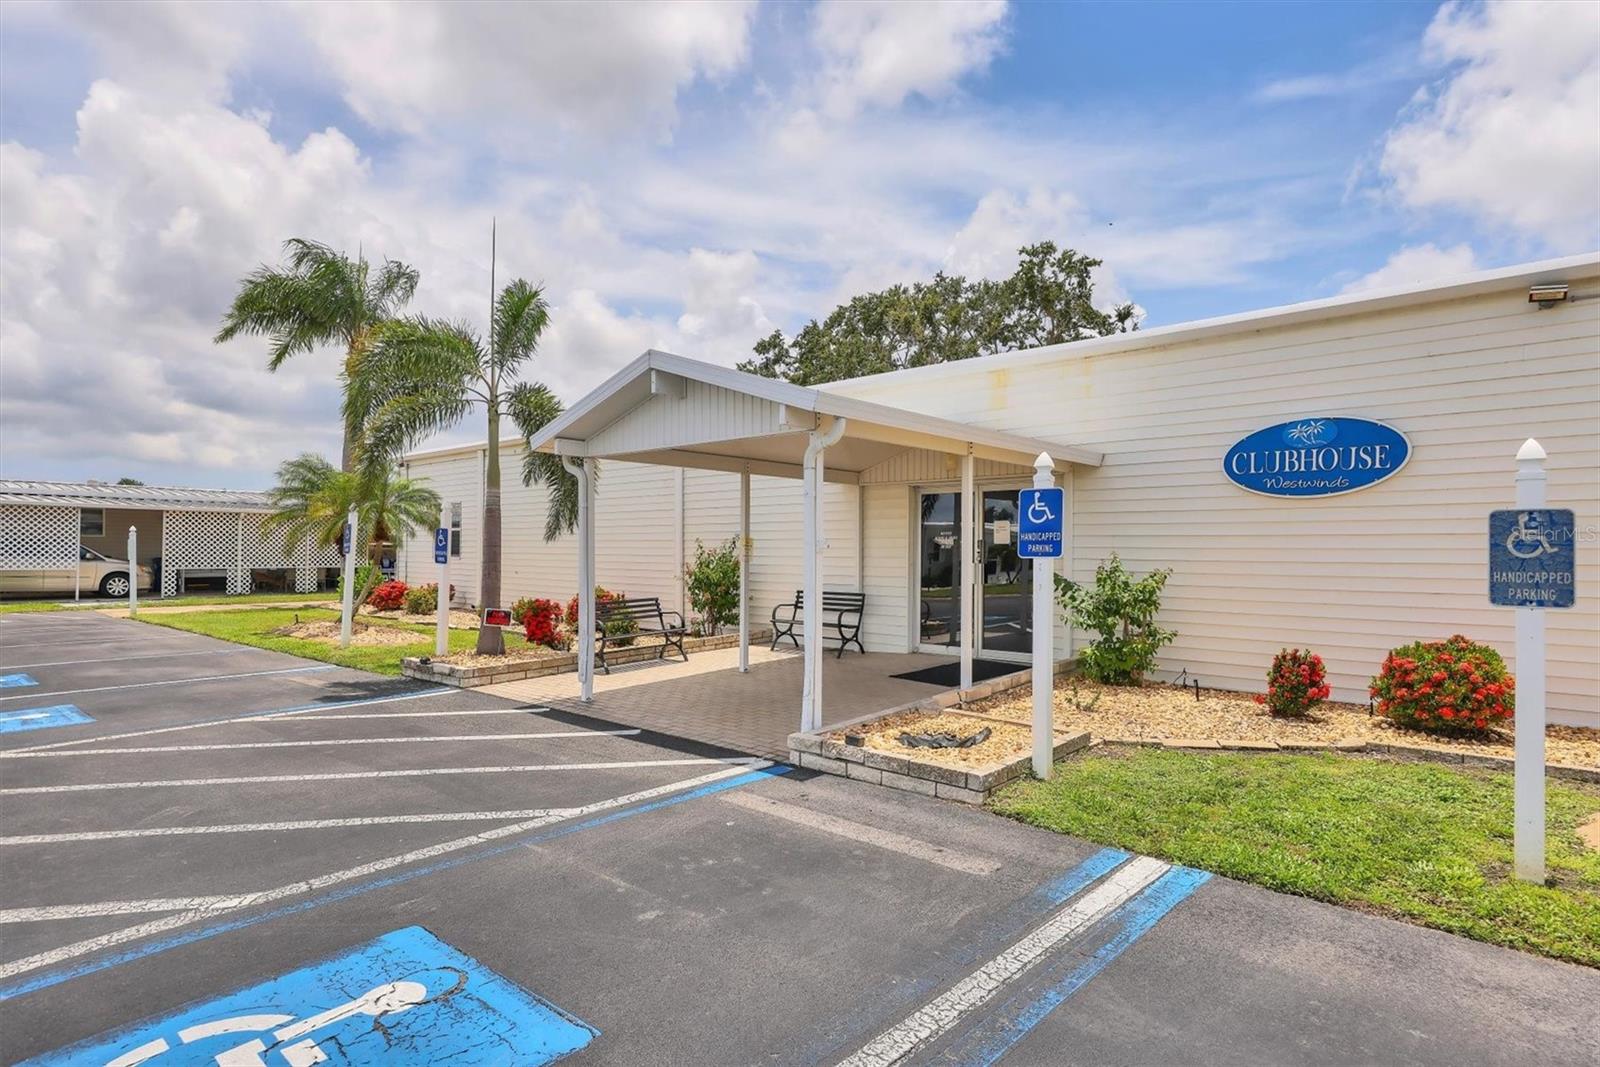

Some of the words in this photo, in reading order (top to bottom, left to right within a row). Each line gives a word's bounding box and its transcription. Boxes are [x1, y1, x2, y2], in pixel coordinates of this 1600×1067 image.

[1231, 444, 1392, 475] CLUBHOUSE
[1263, 475, 1350, 489] Westwinds
[1020, 532, 1062, 542] HANDICAPPED
[1027, 544, 1054, 553] PARKING
[1493, 571, 1572, 585] HANDICAPPED
[1508, 588, 1558, 601] PARKING
